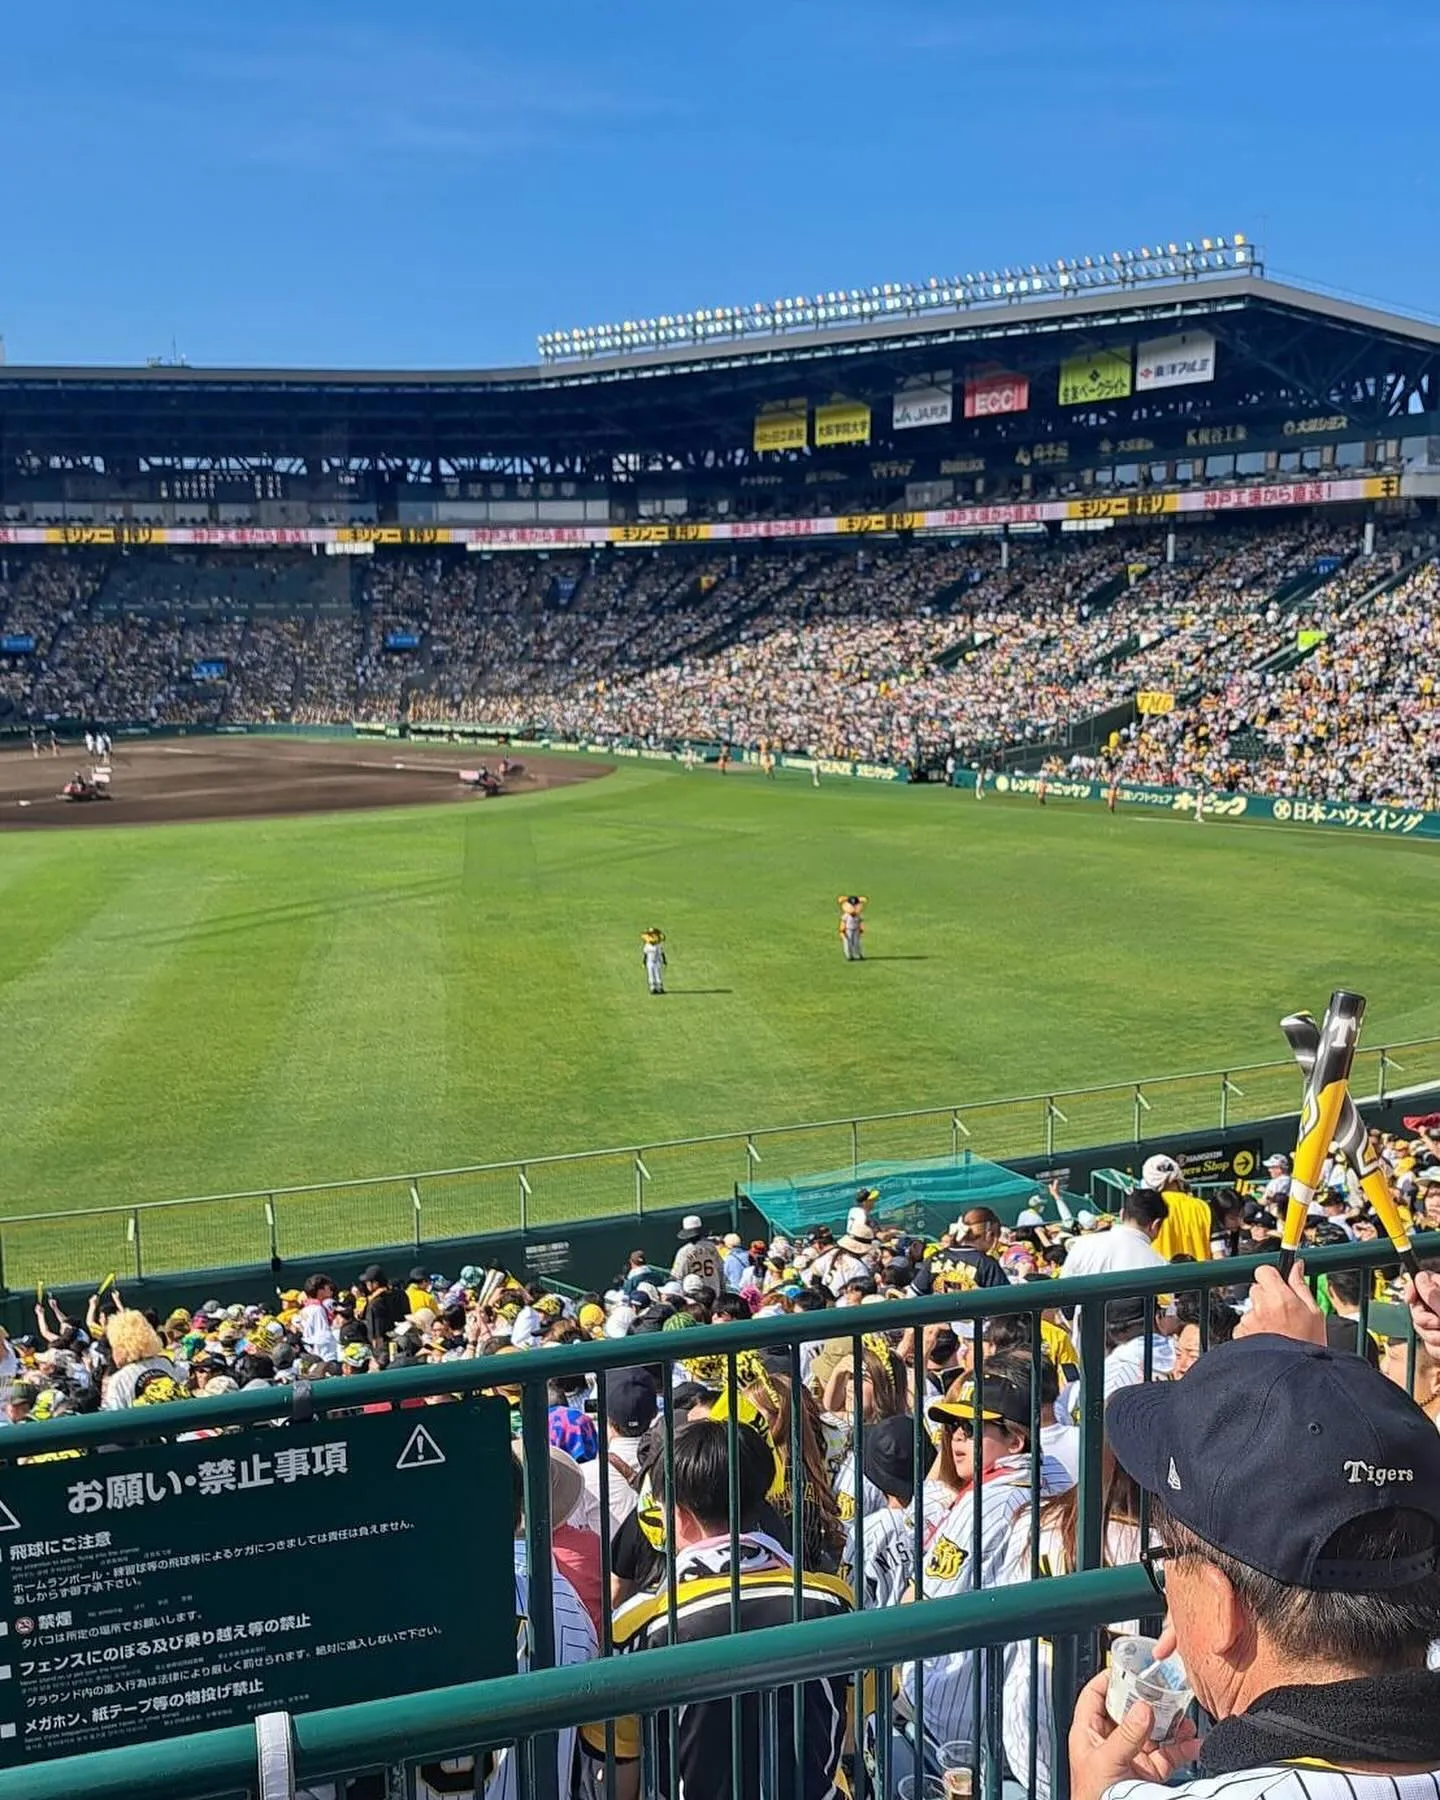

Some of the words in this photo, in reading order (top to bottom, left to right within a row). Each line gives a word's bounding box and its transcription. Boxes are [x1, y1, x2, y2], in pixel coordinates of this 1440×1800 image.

[975, 389, 1014, 414] ECC
[623, 527, 700, 541] キリン一搾り
[1011, 777, 1091, 798] レンタのニッケン
[1293, 801, 1424, 833] 日本ハウズイング
[1203, 1160, 1230, 1172] Shop
[691, 1259, 714, 1277] 26
[68, 1442, 347, 1513] お願い・禁止事項
[1343, 1459, 1414, 1486] Tigers
[10, 1532, 111, 1560] 飛球にご注意
[22, 1611, 201, 1648] タバコは所定の場所でお願いします。
[38, 1611, 72, 1629] 禁煙
[20, 1613, 311, 1675] フェンスにのぼる及び乗り越え等の禁止
[26, 1679, 264, 1733] メガホン、紙テープ等の物投げ禁止
